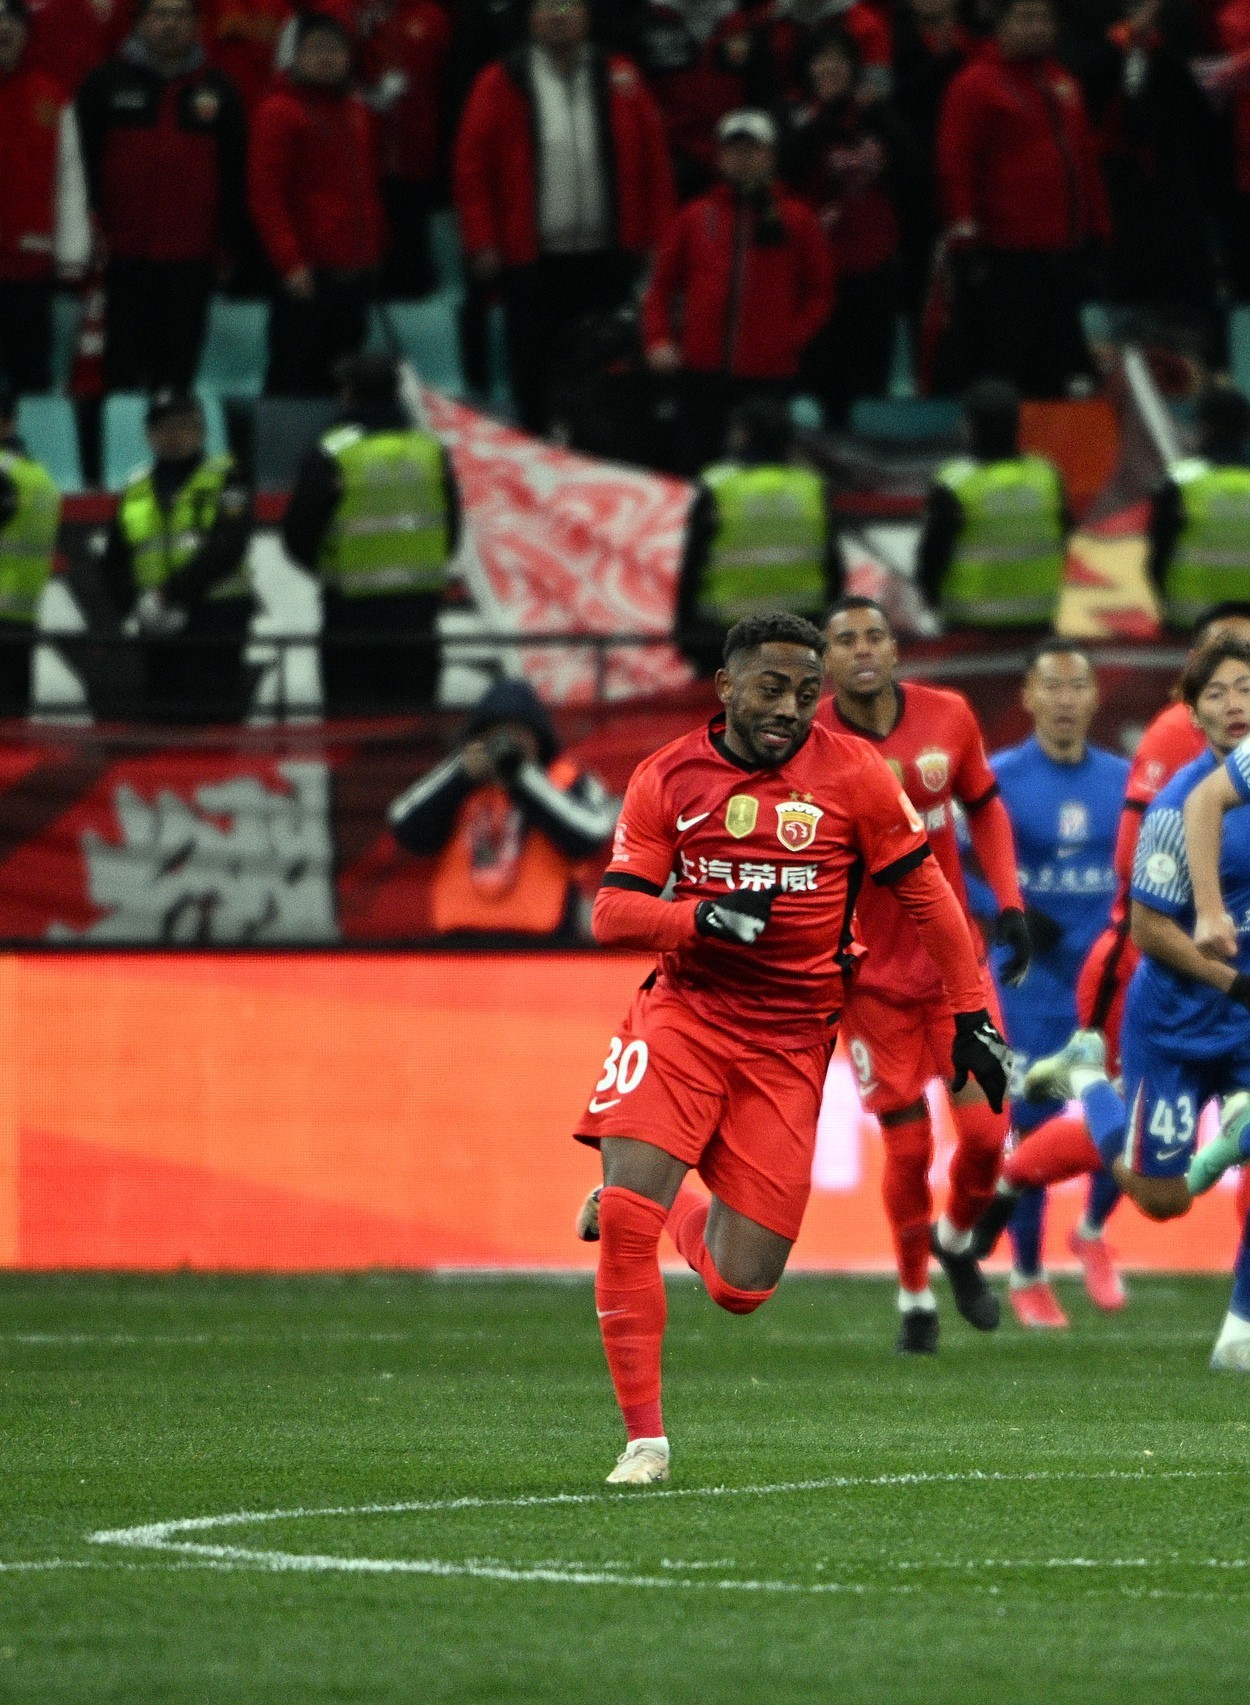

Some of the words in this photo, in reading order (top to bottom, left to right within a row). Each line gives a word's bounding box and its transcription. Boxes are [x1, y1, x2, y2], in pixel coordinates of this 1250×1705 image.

[680, 850, 819, 892] 上汽荣威
[596, 1036, 648, 1094] 30
[851, 1038, 871, 1083] 9
[1150, 1095, 1195, 1145] 43
